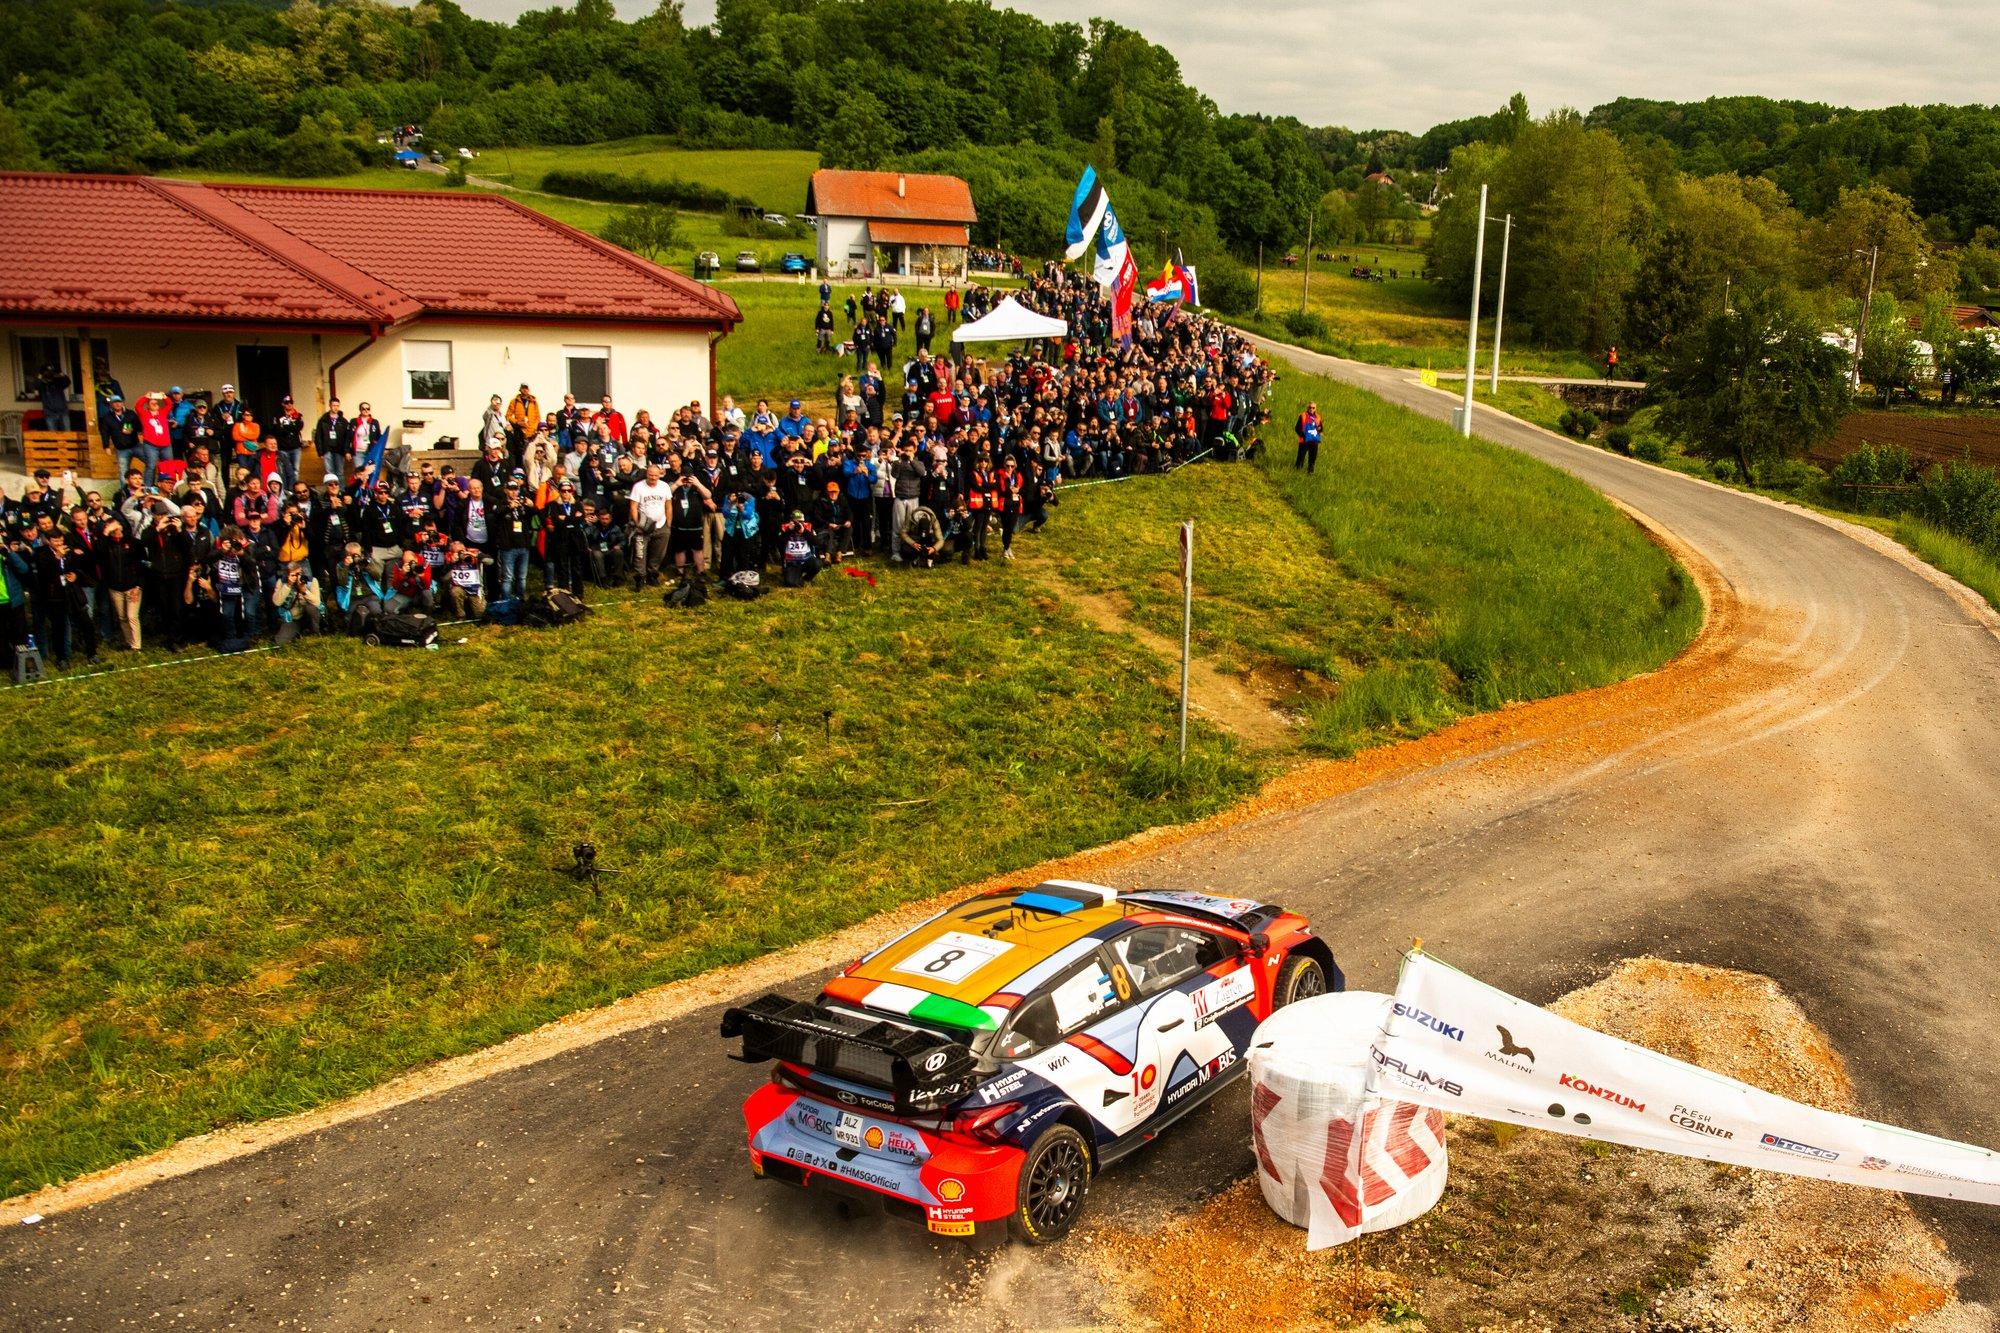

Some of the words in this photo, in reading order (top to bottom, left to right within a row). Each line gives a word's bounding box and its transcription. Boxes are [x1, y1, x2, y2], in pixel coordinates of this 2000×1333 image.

[790, 542, 805, 551] 247
[923, 949, 966, 973] 8
[1112, 963, 1131, 1000] 8
[1392, 1002, 1465, 1042] SUZUKI
[1047, 1055, 1070, 1072] WIA
[1370, 1044, 1464, 1097] ORUM8
[1484, 1050, 1533, 1075] MALFINI
[995, 1068, 1028, 1089] HYUNDAI
[999, 1080, 1024, 1097] STEEL
[1558, 1072, 1647, 1113] KONZUM
[860, 1097, 895, 1112] ForCraig
[1673, 1104, 1712, 1123] FRESH
[797, 1110, 833, 1136] MOBIS
[843, 1114, 859, 1129] ALZ
[845, 1133, 860, 1146] 931
[887, 1137, 917, 1151] HELIX
[887, 1146, 916, 1158] ULTRA
[840, 1164, 901, 1192] #HMSGOfficial
[1899, 1163, 1949, 1180] REPUBLIC
